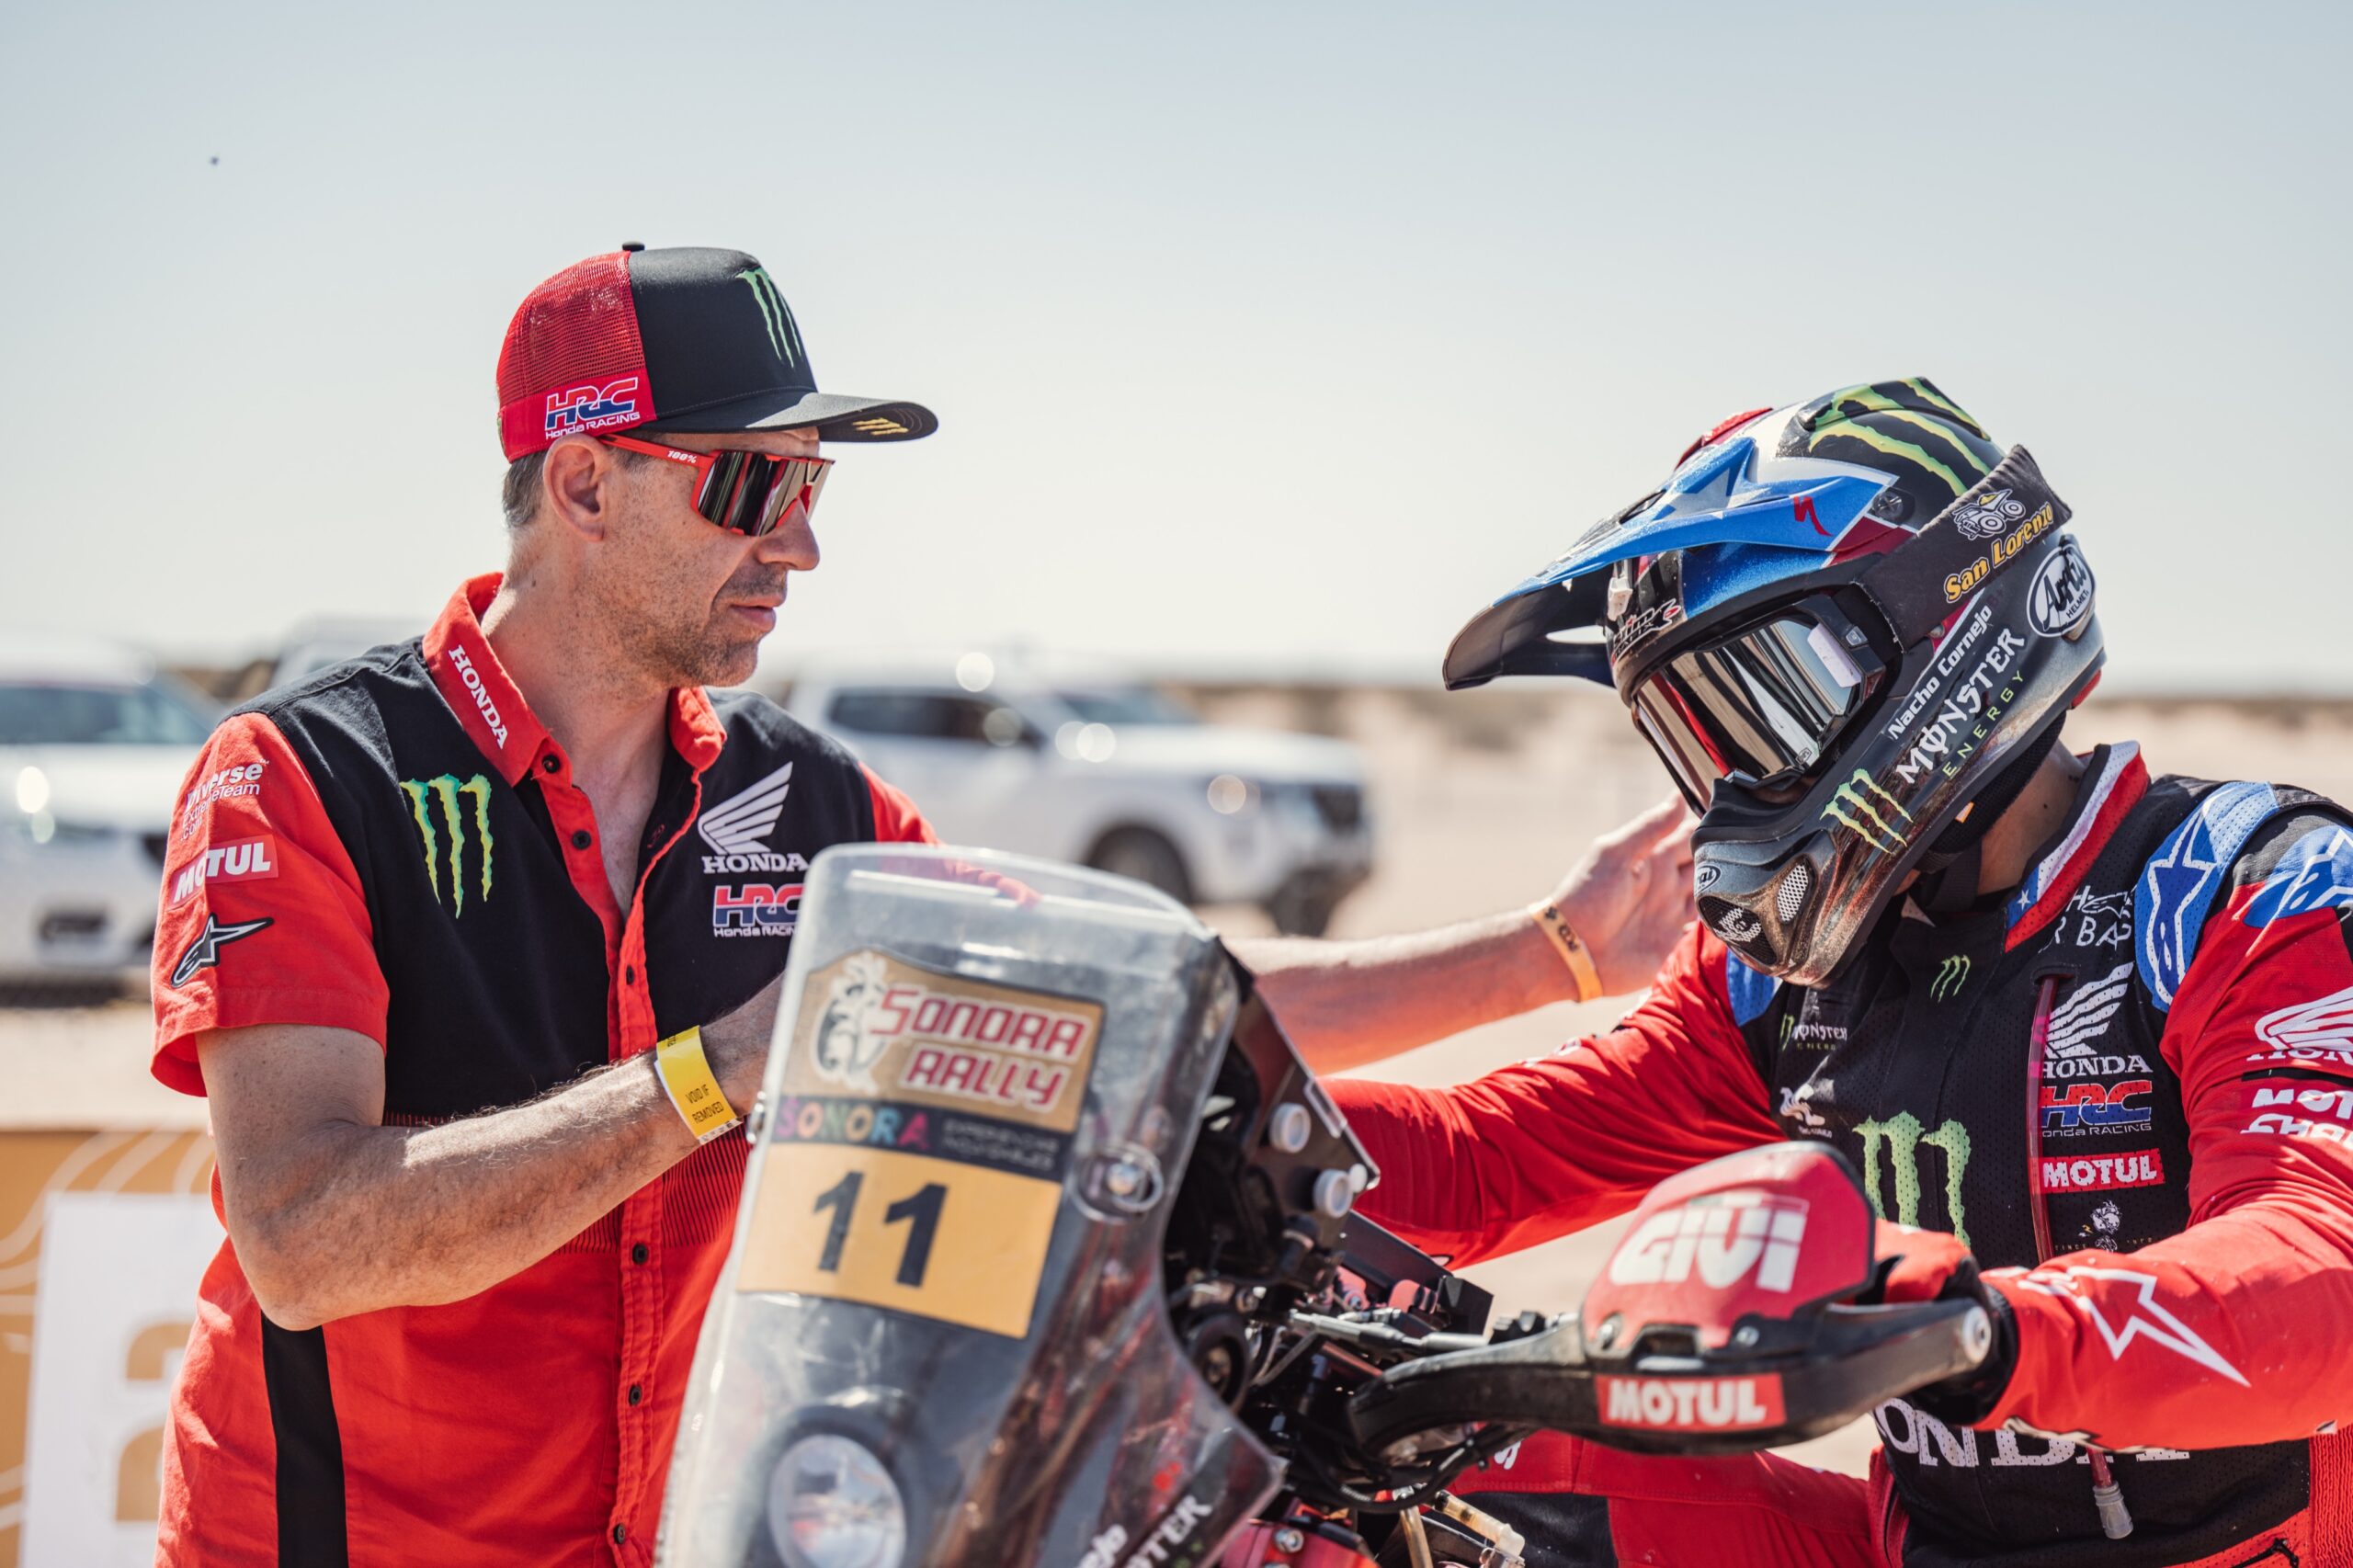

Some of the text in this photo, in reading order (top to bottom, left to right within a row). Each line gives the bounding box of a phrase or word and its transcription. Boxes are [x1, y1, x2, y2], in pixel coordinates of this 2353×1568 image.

[544, 376, 639, 431] HRC
[545, 411, 641, 440] Honda RACING
[667, 449, 698, 464] 100%
[1944, 501, 2054, 604] San Lorenzo
[448, 644, 508, 750] HONDA
[1887, 605, 1993, 741] Nacho Cornejo
[1895, 628, 2025, 784] MONSTER
[1942, 669, 2024, 778] ENERGY
[173, 842, 272, 903] MOTUL
[701, 852, 810, 874] HONDA
[713, 882, 806, 928] HRC
[713, 925, 796, 937] Honda RACIN
[870, 987, 1086, 1057] SONORA
[685, 1084, 710, 1104] VOID IF
[905, 1048, 1064, 1105] RALLY
[691, 1101, 725, 1123] REMOVED
[775, 1096, 929, 1149] SONORA
[2041, 1079, 2153, 1129] HRC
[2042, 1122, 2152, 1139] onda RACING
[2042, 1154, 2158, 1187] MOTUL
[813, 1169, 949, 1290] 11
[1610, 1205, 1808, 1293] GIVI
[1608, 1379, 1767, 1426] MOTUL
